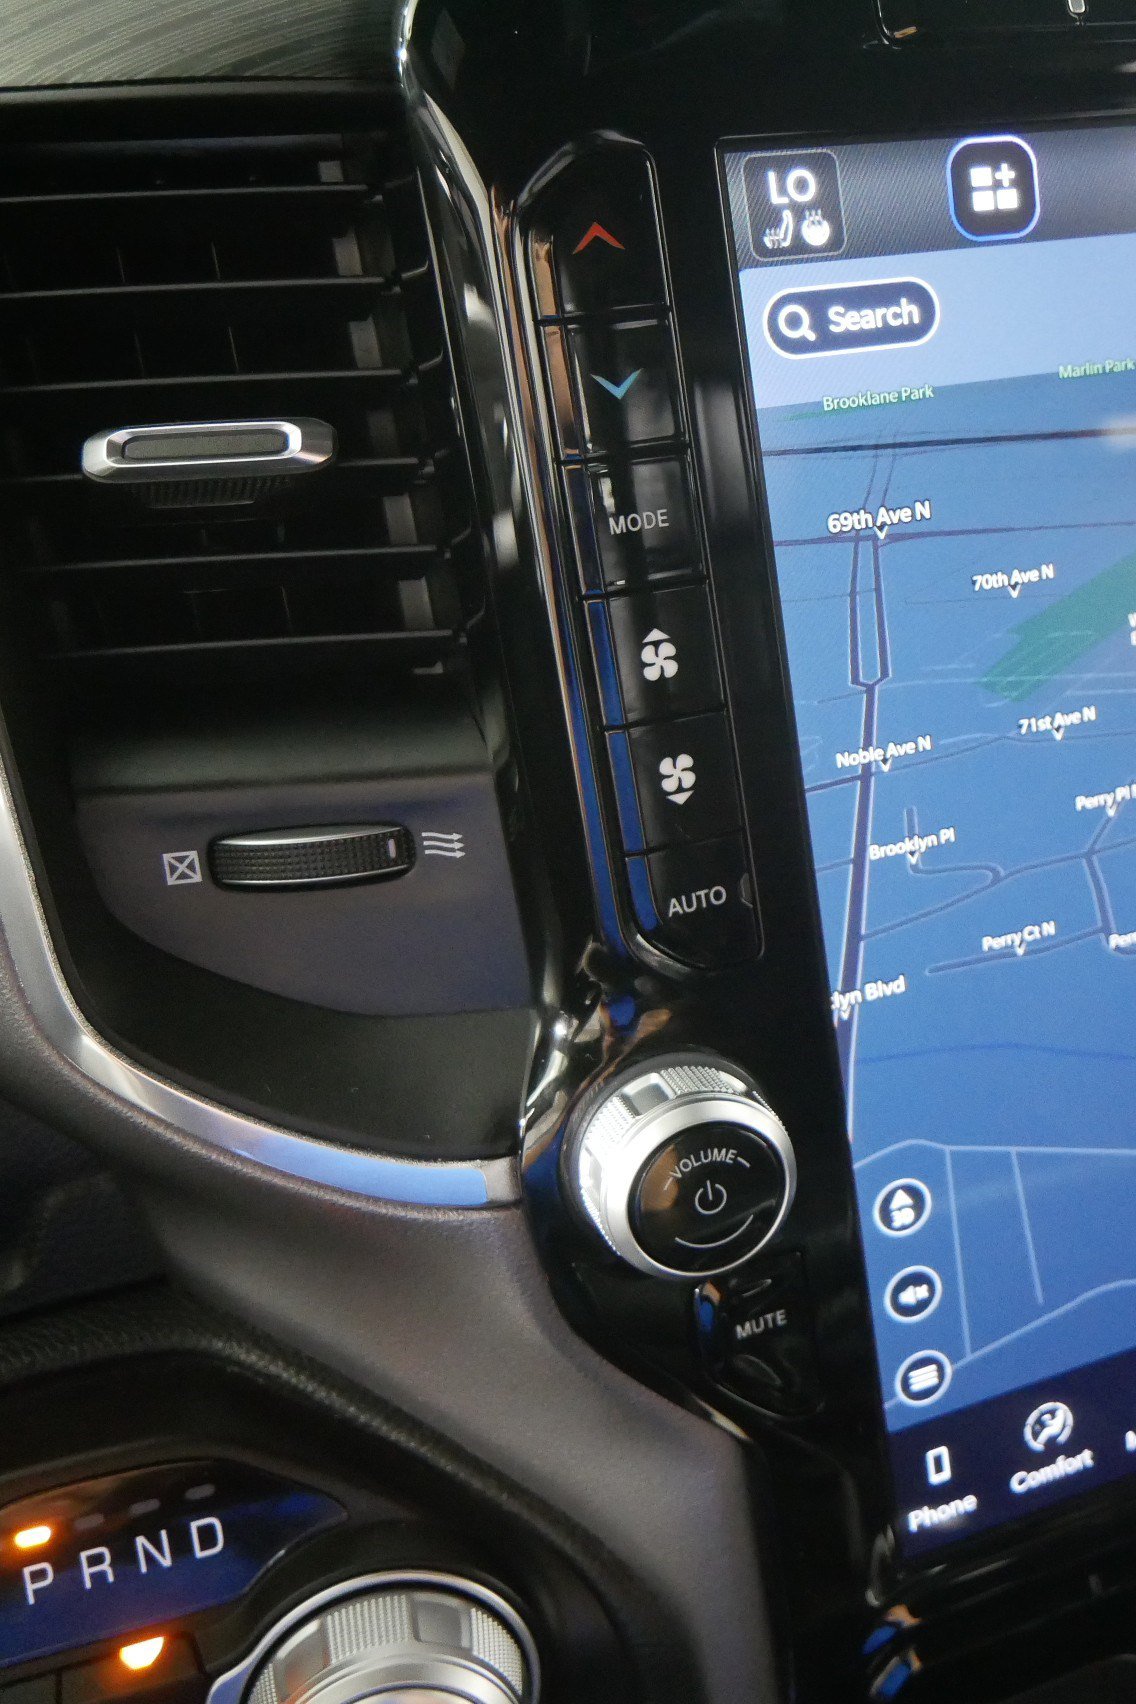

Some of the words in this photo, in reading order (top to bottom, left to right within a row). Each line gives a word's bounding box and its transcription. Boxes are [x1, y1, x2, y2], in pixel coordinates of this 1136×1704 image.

[767, 168, 816, 204] LO
[827, 296, 921, 333] Search
[1058, 363, 1101, 380] Marlin
[1104, 357, 1136, 374] Park
[822, 389, 899, 412] Brooklane
[900, 383, 935, 403] Park
[608, 508, 670, 536] MODE
[827, 509, 873, 534] 69th
[875, 504, 912, 526] Ave
[914, 500, 932, 520] N
[971, 570, 1009, 591] 70th
[1010, 567, 1040, 586] Ave
[1040, 563, 1055, 580] N
[1018, 715, 1052, 735] 71st
[1052, 711, 1081, 729] Ave
[1081, 706, 1097, 723] N
[836, 749, 886, 769] Noble
[886, 741, 916, 760] Ave
[916, 735, 932, 752] N
[868, 834, 939, 861] Brooklyn
[939, 827, 956, 845] Pl
[667, 884, 728, 918] AUTO
[1042, 920, 1057, 937] N
[864, 974, 906, 1001] Blvd
[671, 1147, 738, 1180] VOLUME
[734, 1308, 789, 1341] MUTE
[1009, 1448, 1095, 1494] Comfort
[907, 1494, 979, 1533] Phone
[21, 1561, 55, 1605] P
[80, 1546, 116, 1590] R
[135, 1529, 174, 1574] N
[189, 1516, 226, 1559] D
